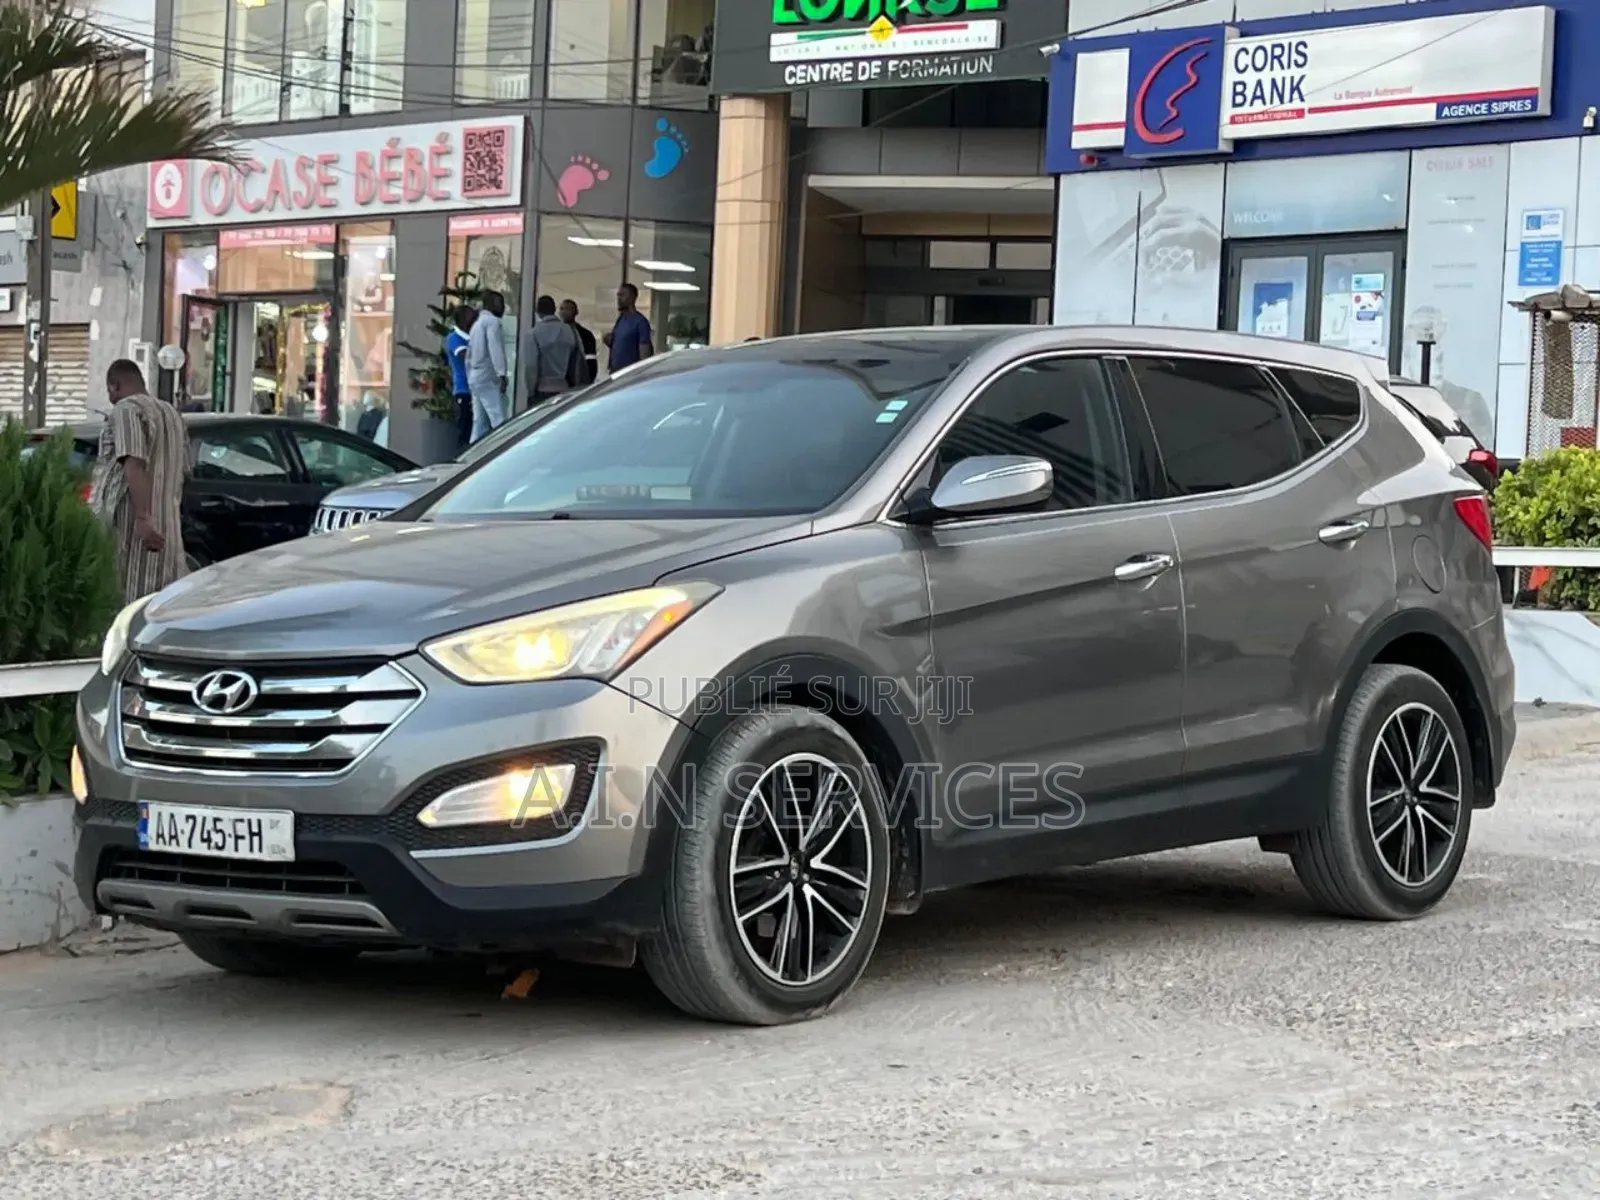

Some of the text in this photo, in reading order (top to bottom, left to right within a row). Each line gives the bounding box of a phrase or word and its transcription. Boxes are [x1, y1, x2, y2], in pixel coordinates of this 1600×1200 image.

[784, 63, 853, 85] CENTRE
[858, 60, 882, 81] DE
[1234, 40, 1309, 74] CORIS
[1231, 74, 1307, 108] BANK
[1441, 99, 1532, 117] AGENCE SIPRES
[354, 131, 453, 206] BÉBÉ
[156, 811, 263, 853] AA-745-FH
